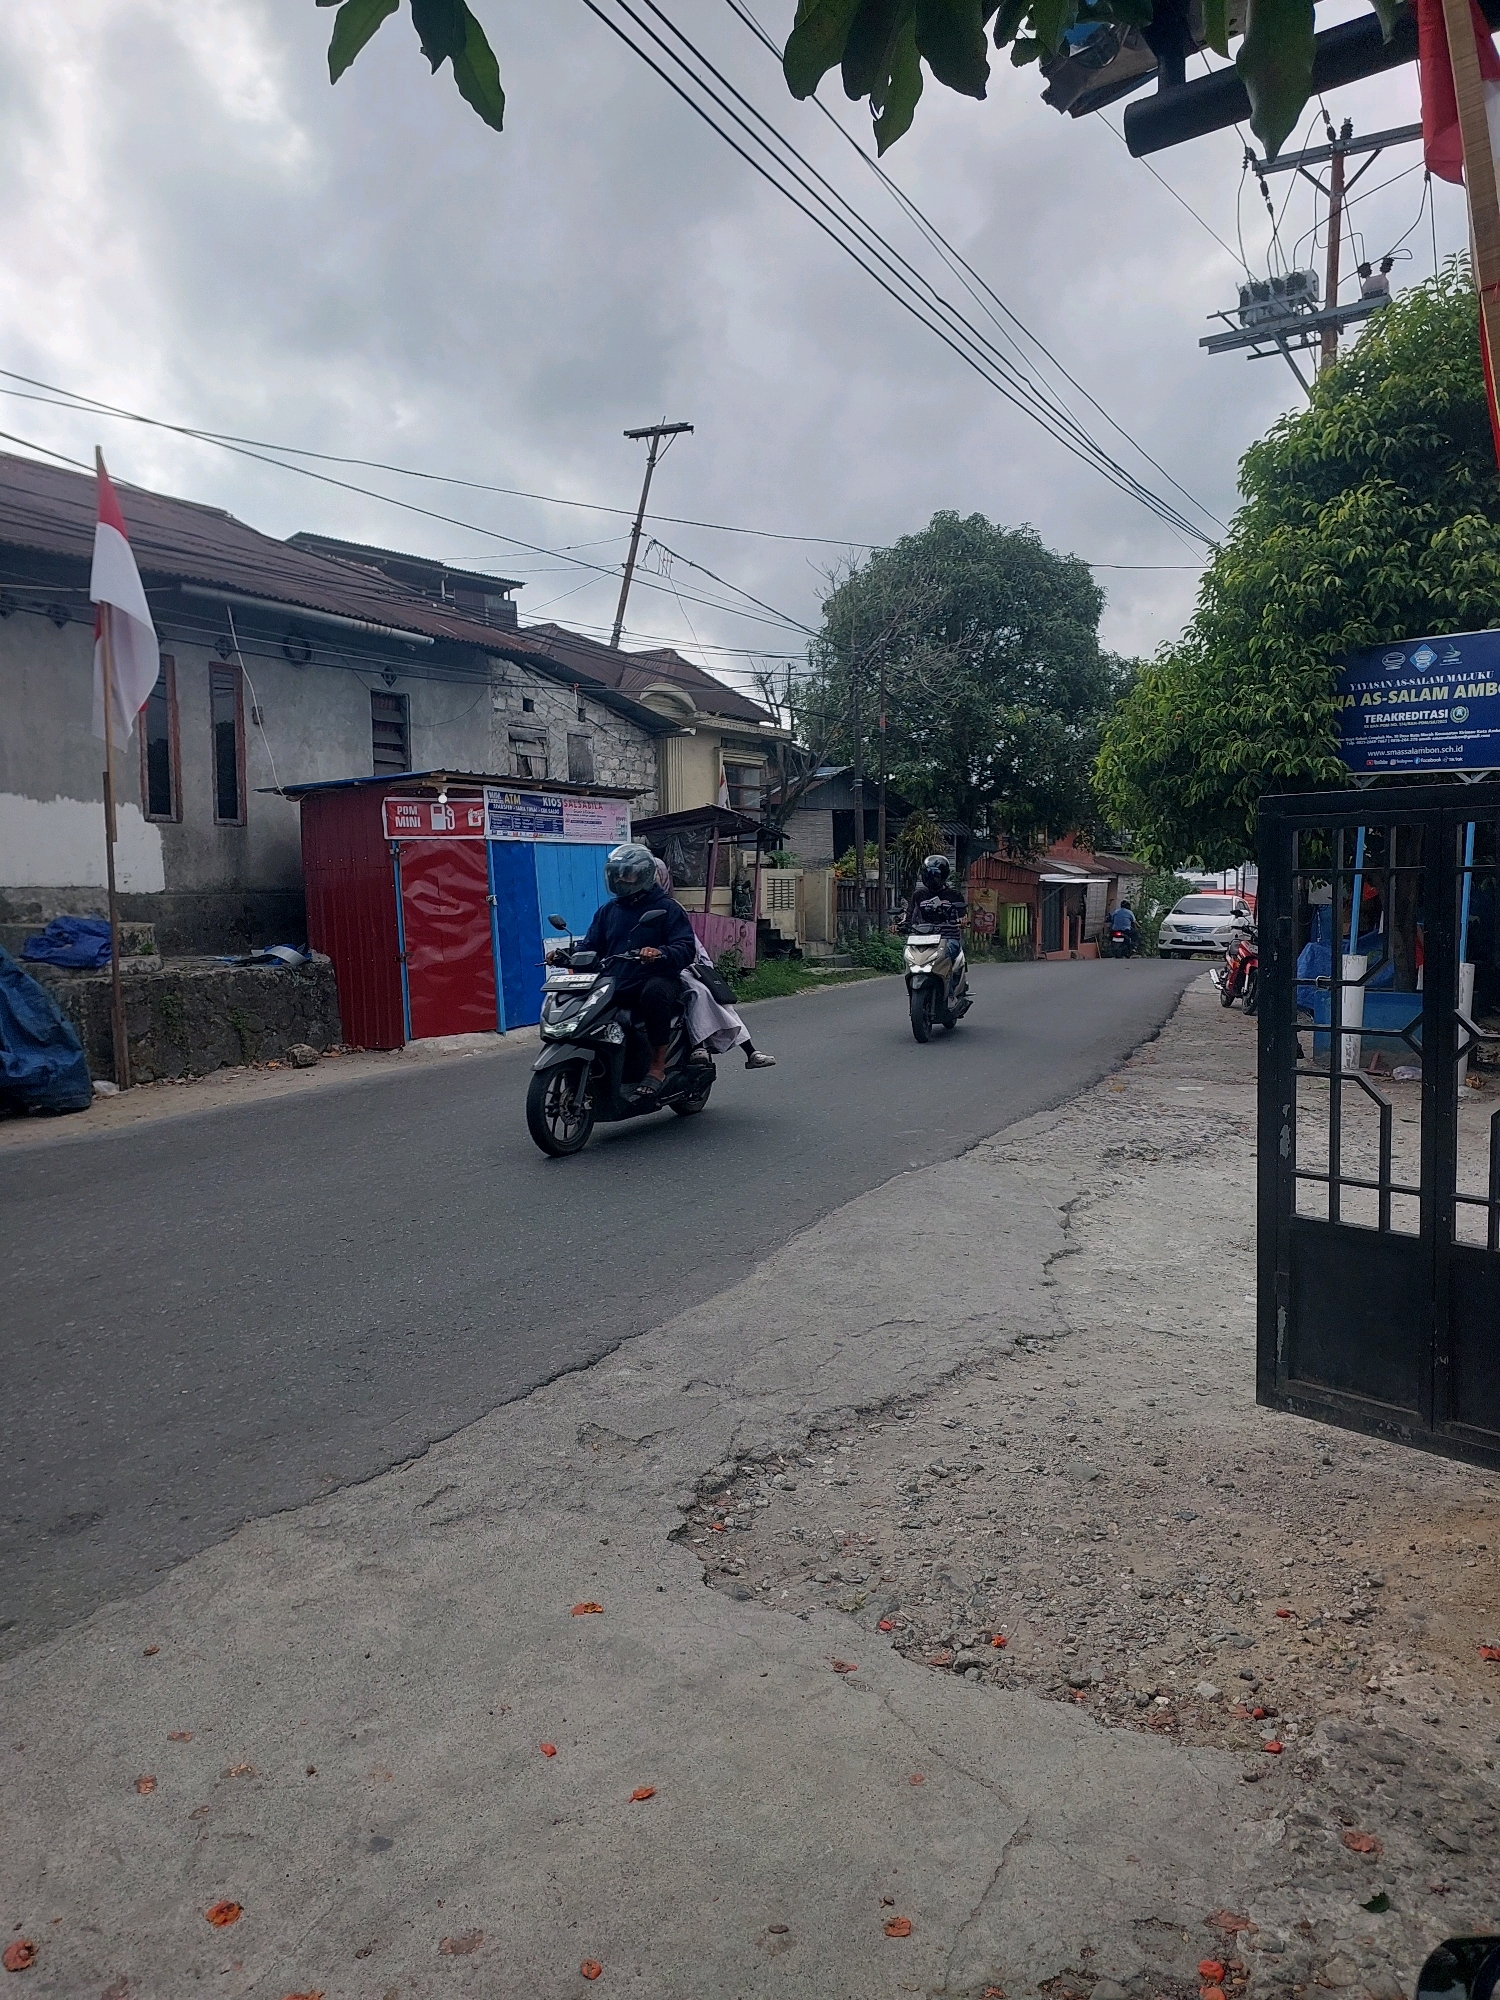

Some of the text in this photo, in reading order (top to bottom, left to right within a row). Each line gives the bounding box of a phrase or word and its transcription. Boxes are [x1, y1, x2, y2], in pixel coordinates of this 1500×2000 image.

[1350, 670, 1494, 691] YAYASAN AS-SALAM MALUKU
[1330, 682, 1500, 708] MA AS-SALAM AMB
[1364, 709, 1449, 724] TERAKREDITASI
[1367, 745, 1464, 757] www.smassalambon.sch.id
[504, 793, 521, 805] ATM
[542, 797, 562, 807] KIOS
[396, 805, 418, 815] POM
[395, 816, 421, 828] MINI
